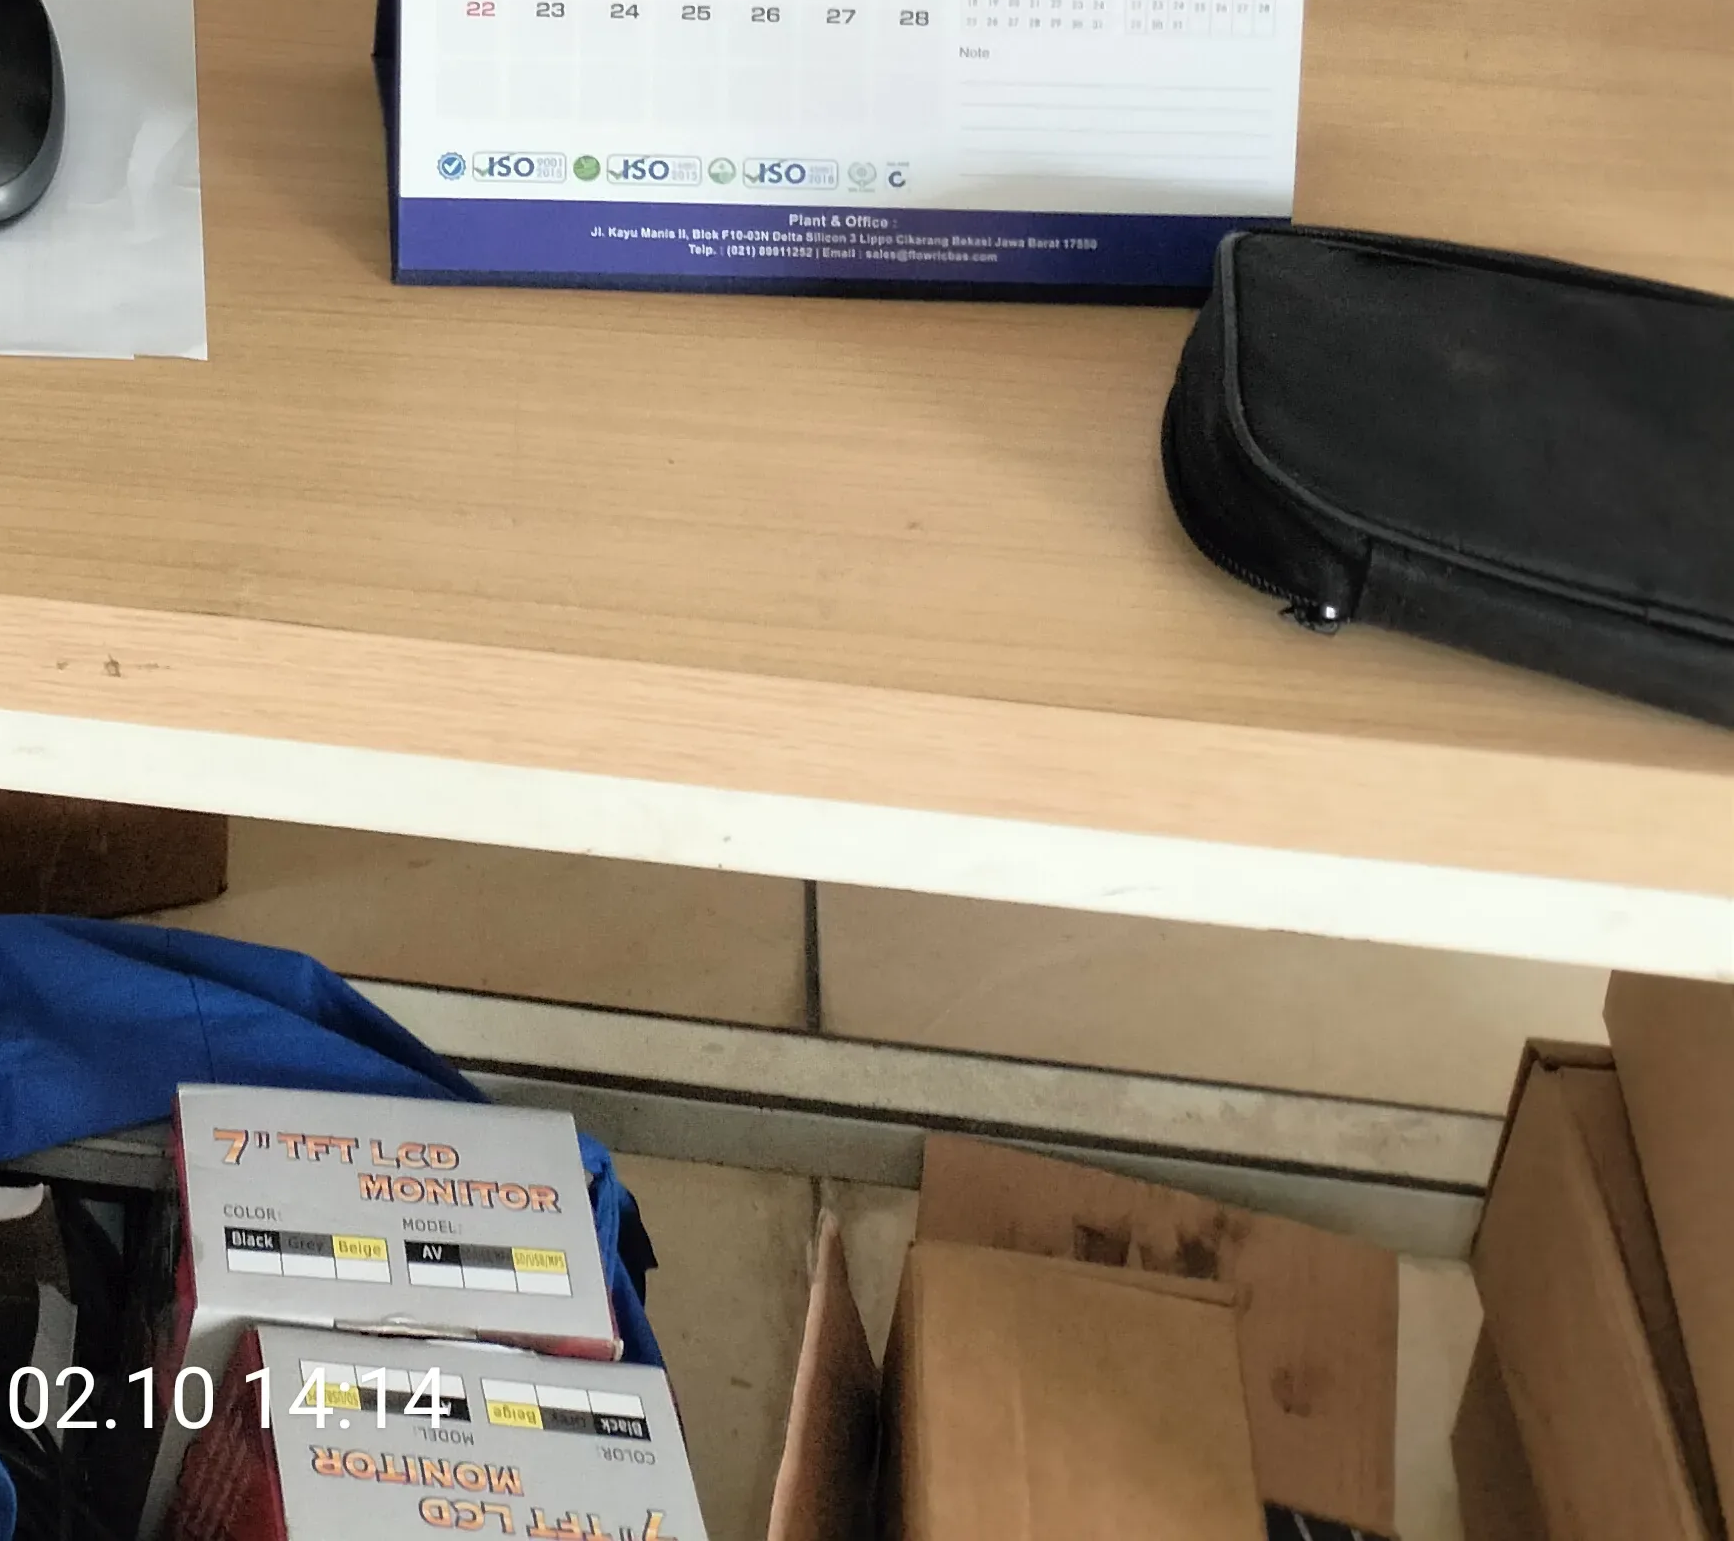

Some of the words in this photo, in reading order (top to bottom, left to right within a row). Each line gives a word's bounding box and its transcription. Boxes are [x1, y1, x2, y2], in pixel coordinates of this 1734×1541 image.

[467, 2, 495, 16] 22
[537, 3, 564, 17] 23
[611, 4, 639, 18] 24
[682, 6, 710, 20] 25
[752, 8, 779, 22] 26
[827, 9, 855, 23] 27
[900, 11, 928, 26] 28
[960, 47, 989, 57] Note
[488, 155, 535, 177] ISO
[623, 158, 669, 180] ISO
[759, 163, 806, 186] ISO
[789, 214, 826, 227] Plant
[831, 216, 840, 227] &
[846, 216, 888, 228] Office
[609, 227, 637, 239] Kayu
[859, 234, 892, 246] Lippo
[213, 1128, 269, 1165] 7"
[277, 1132, 359, 1164] TFT
[370, 1139, 460, 1170] LCD
[357, 1173, 561, 1213] MONITOR
[224, 1204, 282, 1221] COLOR:
[403, 1218, 462, 1235] MODEL:
[231, 1231, 274, 1249] Black
[338, 1241, 382, 1258] Beige
[422, 1245, 442, 1261] AV
[494, 1406, 537, 1425] Beige
[601, 1417, 642, 1438] Black
[310, 1445, 524, 1497] MONITOR
[419, 1497, 515, 1534] LCD
